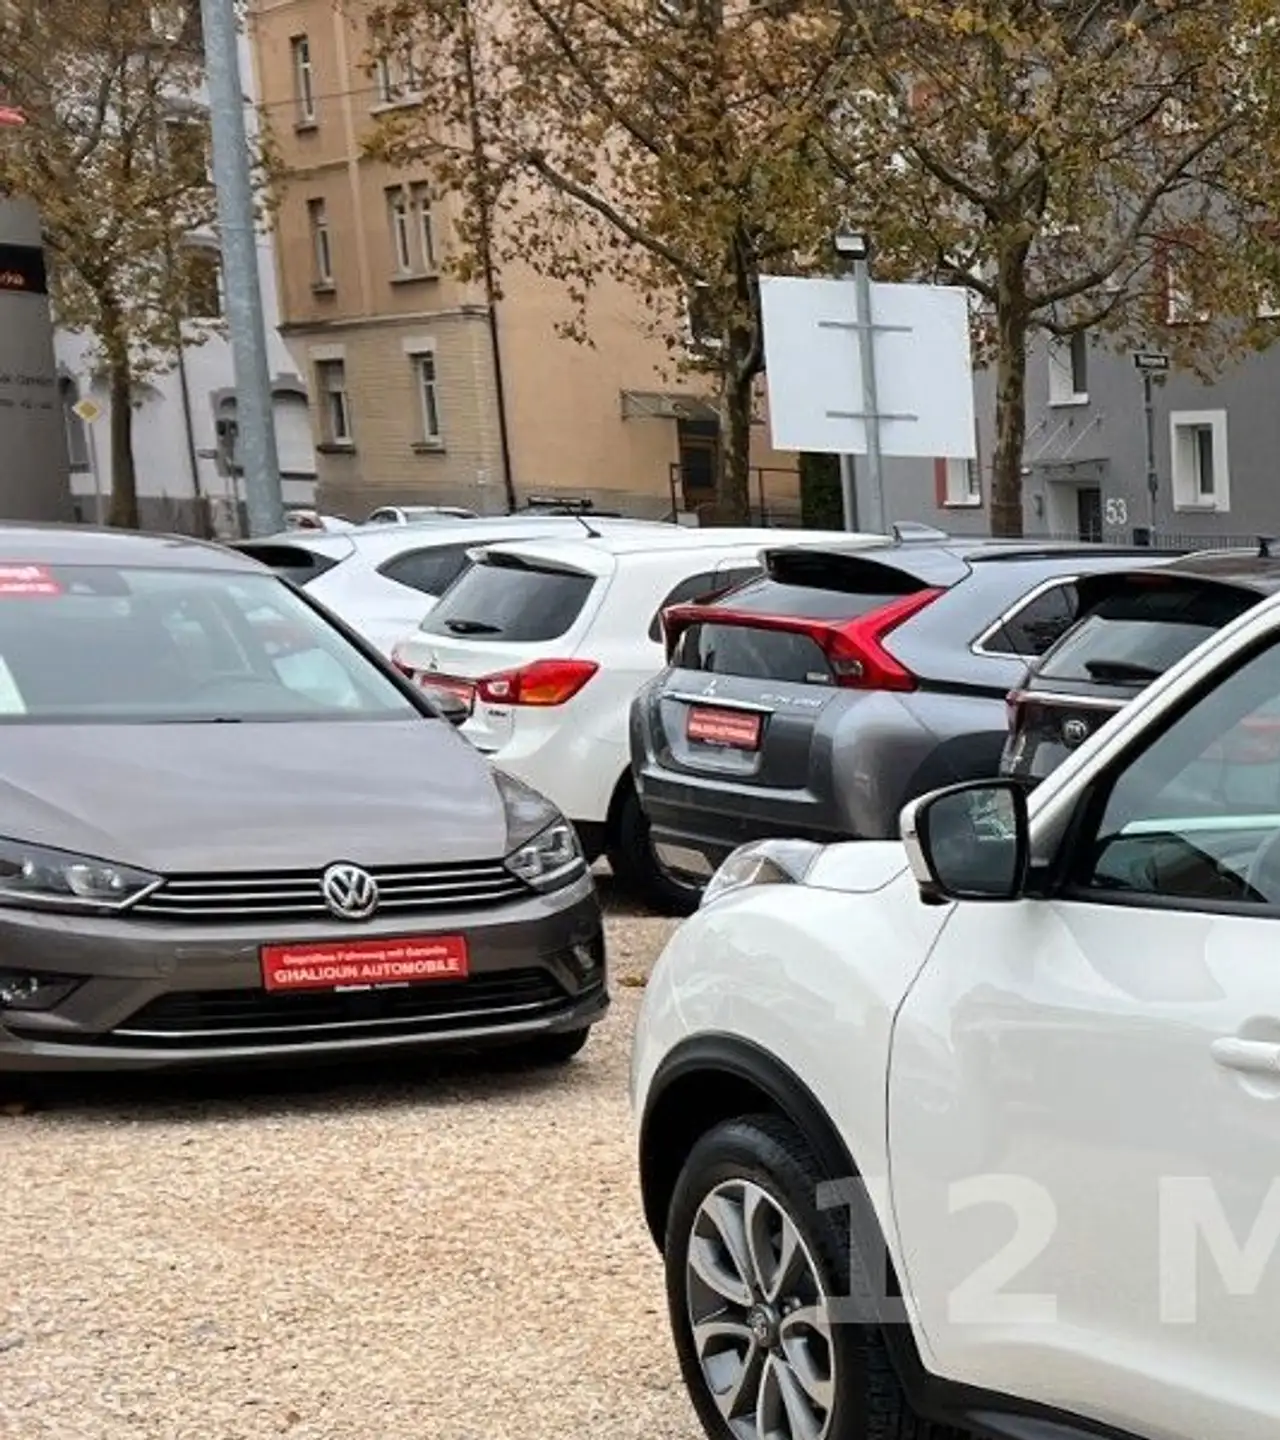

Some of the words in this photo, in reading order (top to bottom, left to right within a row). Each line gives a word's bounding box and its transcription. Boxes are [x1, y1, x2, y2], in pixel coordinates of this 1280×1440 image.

[1106, 498, 1127, 524] 53
[273, 963, 359, 983] GHALIOUN
[360, 957, 460, 977] AUTOMOBILE
